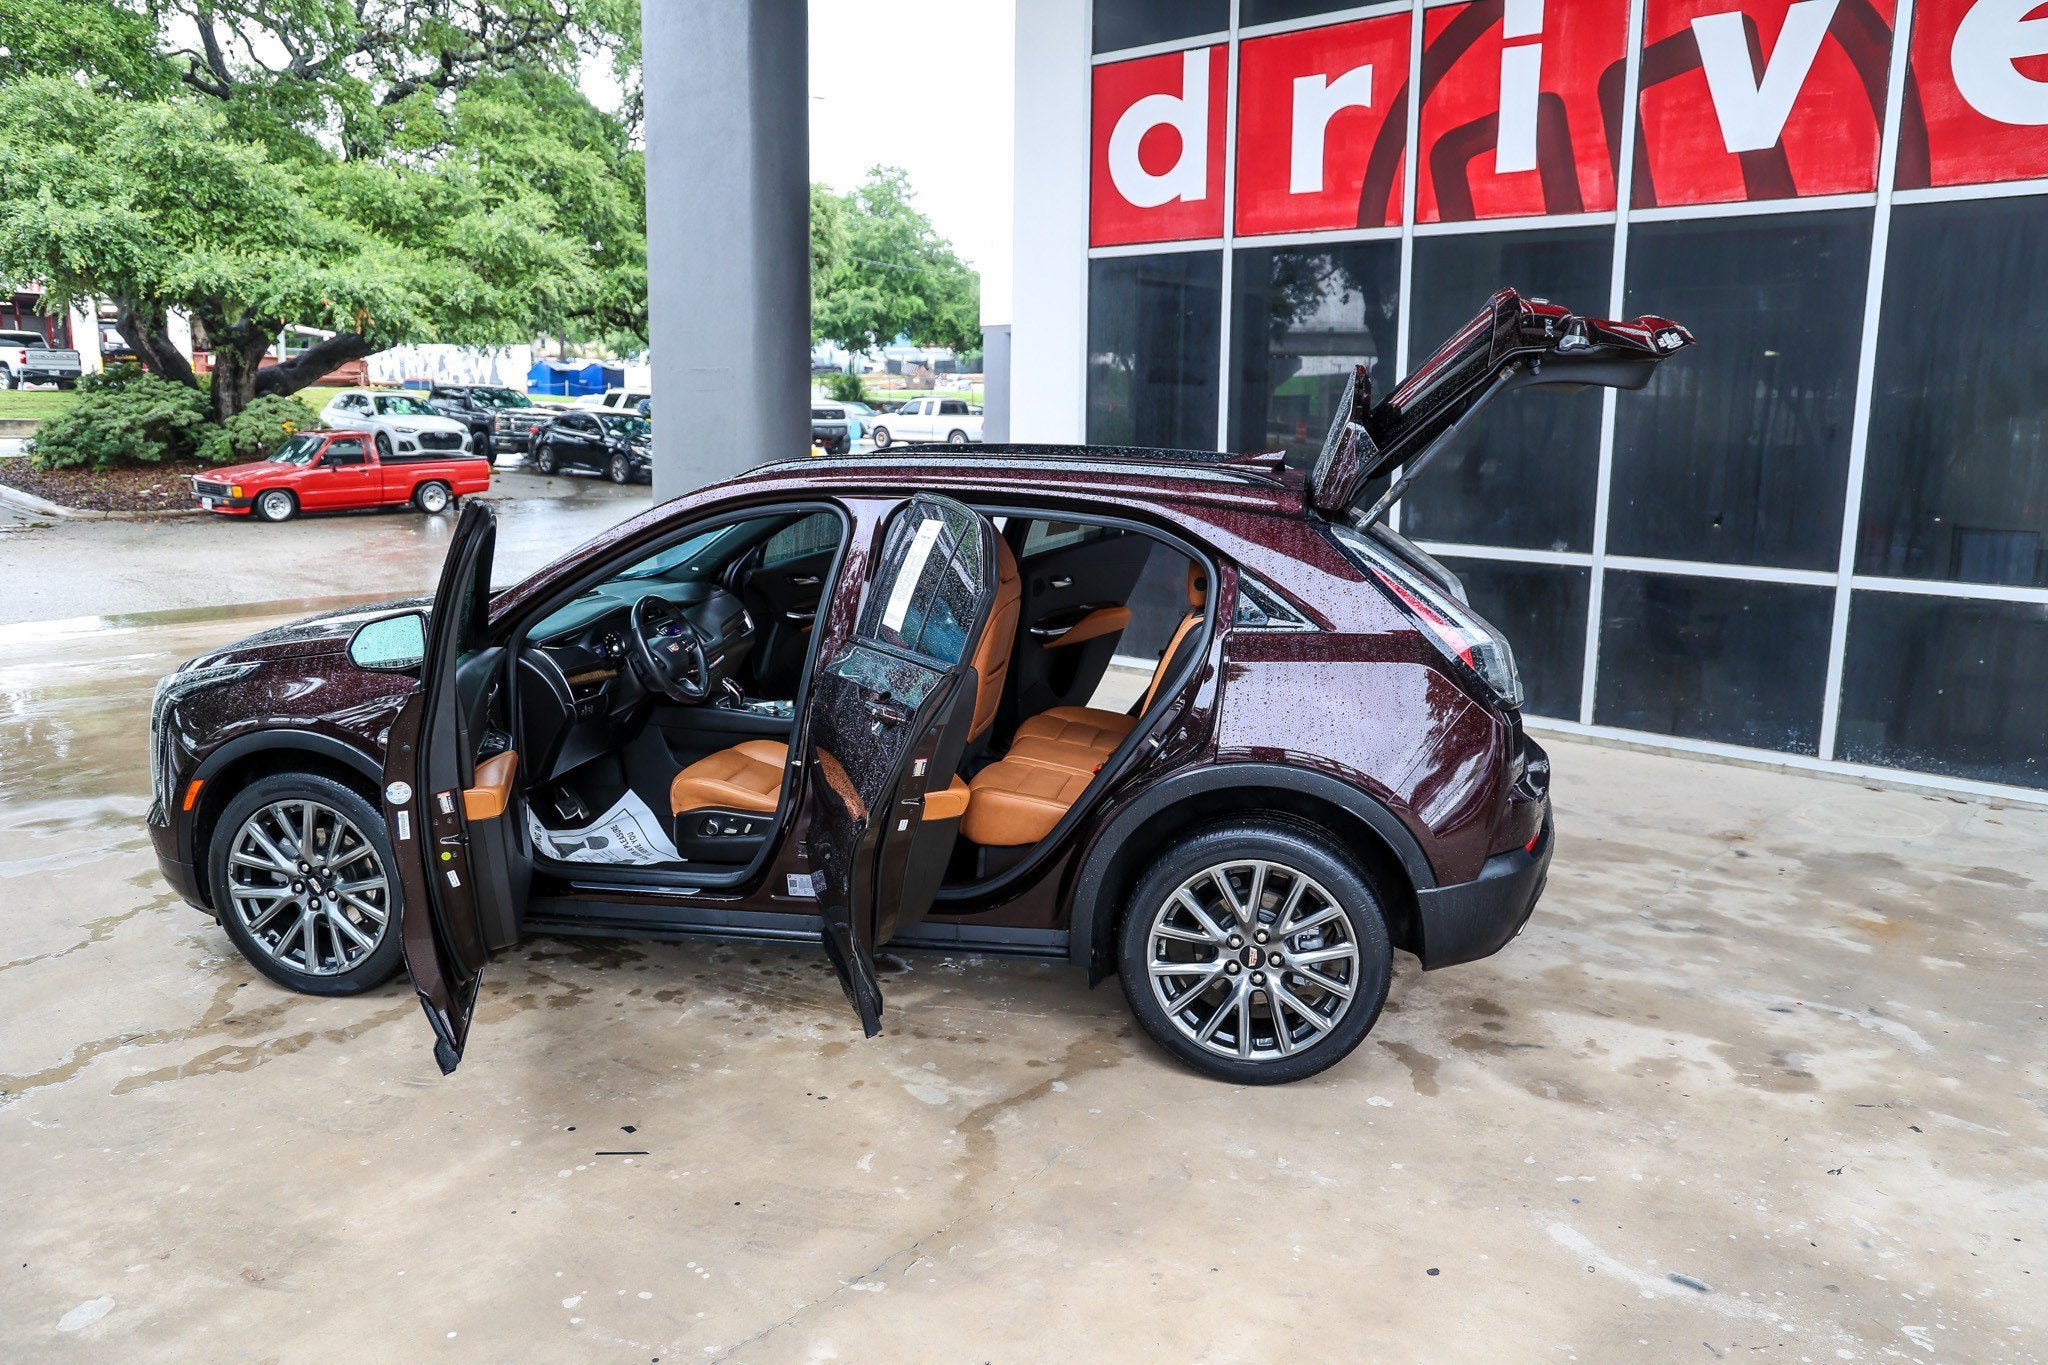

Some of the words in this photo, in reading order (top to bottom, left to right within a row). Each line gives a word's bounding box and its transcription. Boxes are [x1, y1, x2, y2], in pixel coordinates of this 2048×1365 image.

[1107, 0, 2048, 208] drive
[610, 824, 631, 849] PLEASURE
[626, 831, 638, 844] YOU
